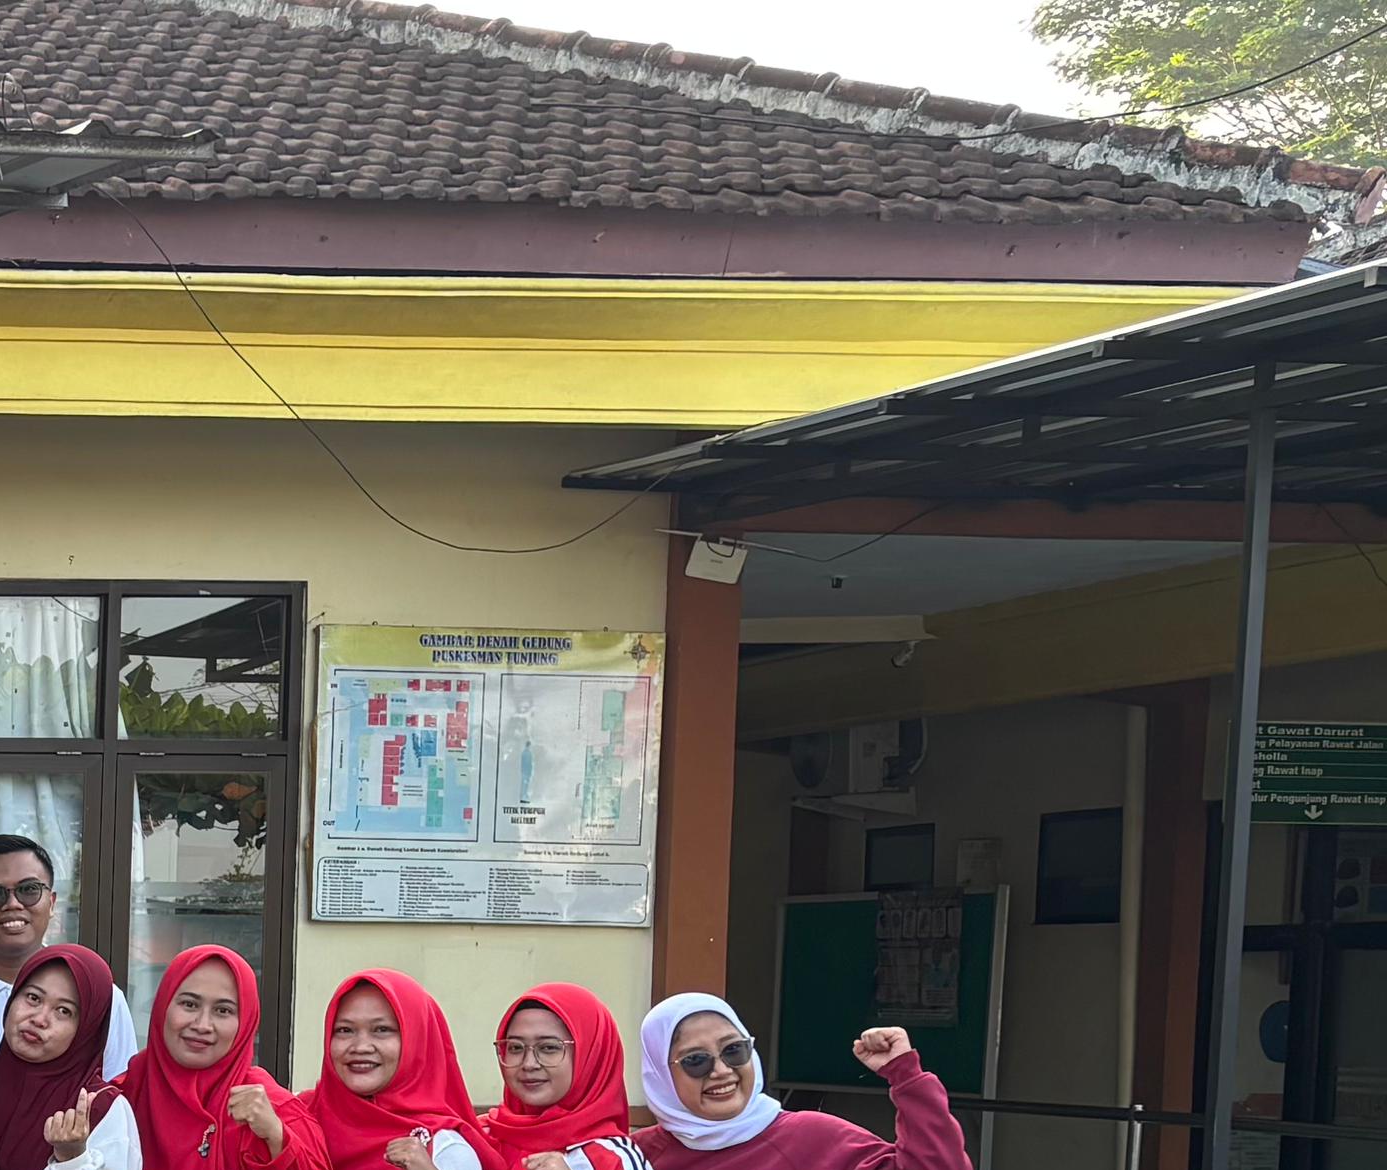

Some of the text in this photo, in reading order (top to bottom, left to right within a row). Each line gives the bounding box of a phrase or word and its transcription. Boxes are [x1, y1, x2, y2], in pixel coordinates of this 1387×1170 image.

[522, 637, 572, 650] GEDUNG
[432, 650, 558, 665] PUSKESMAS TUNJUNG
[1267, 726, 1310, 736] Gawat
[1314, 727, 1364, 736] Darurat
[1268, 739, 1320, 748] Pelayanan
[1322, 740, 1355, 749] Rawat
[1357, 741, 1384, 749] Jalan
[1267, 765, 1299, 775] Rawat
[1301, 766, 1324, 777] Inap
[1270, 793, 1327, 805] Pengunjung
[1330, 794, 1361, 804] Rawat
[1364, 795, 1386, 805] Inap
